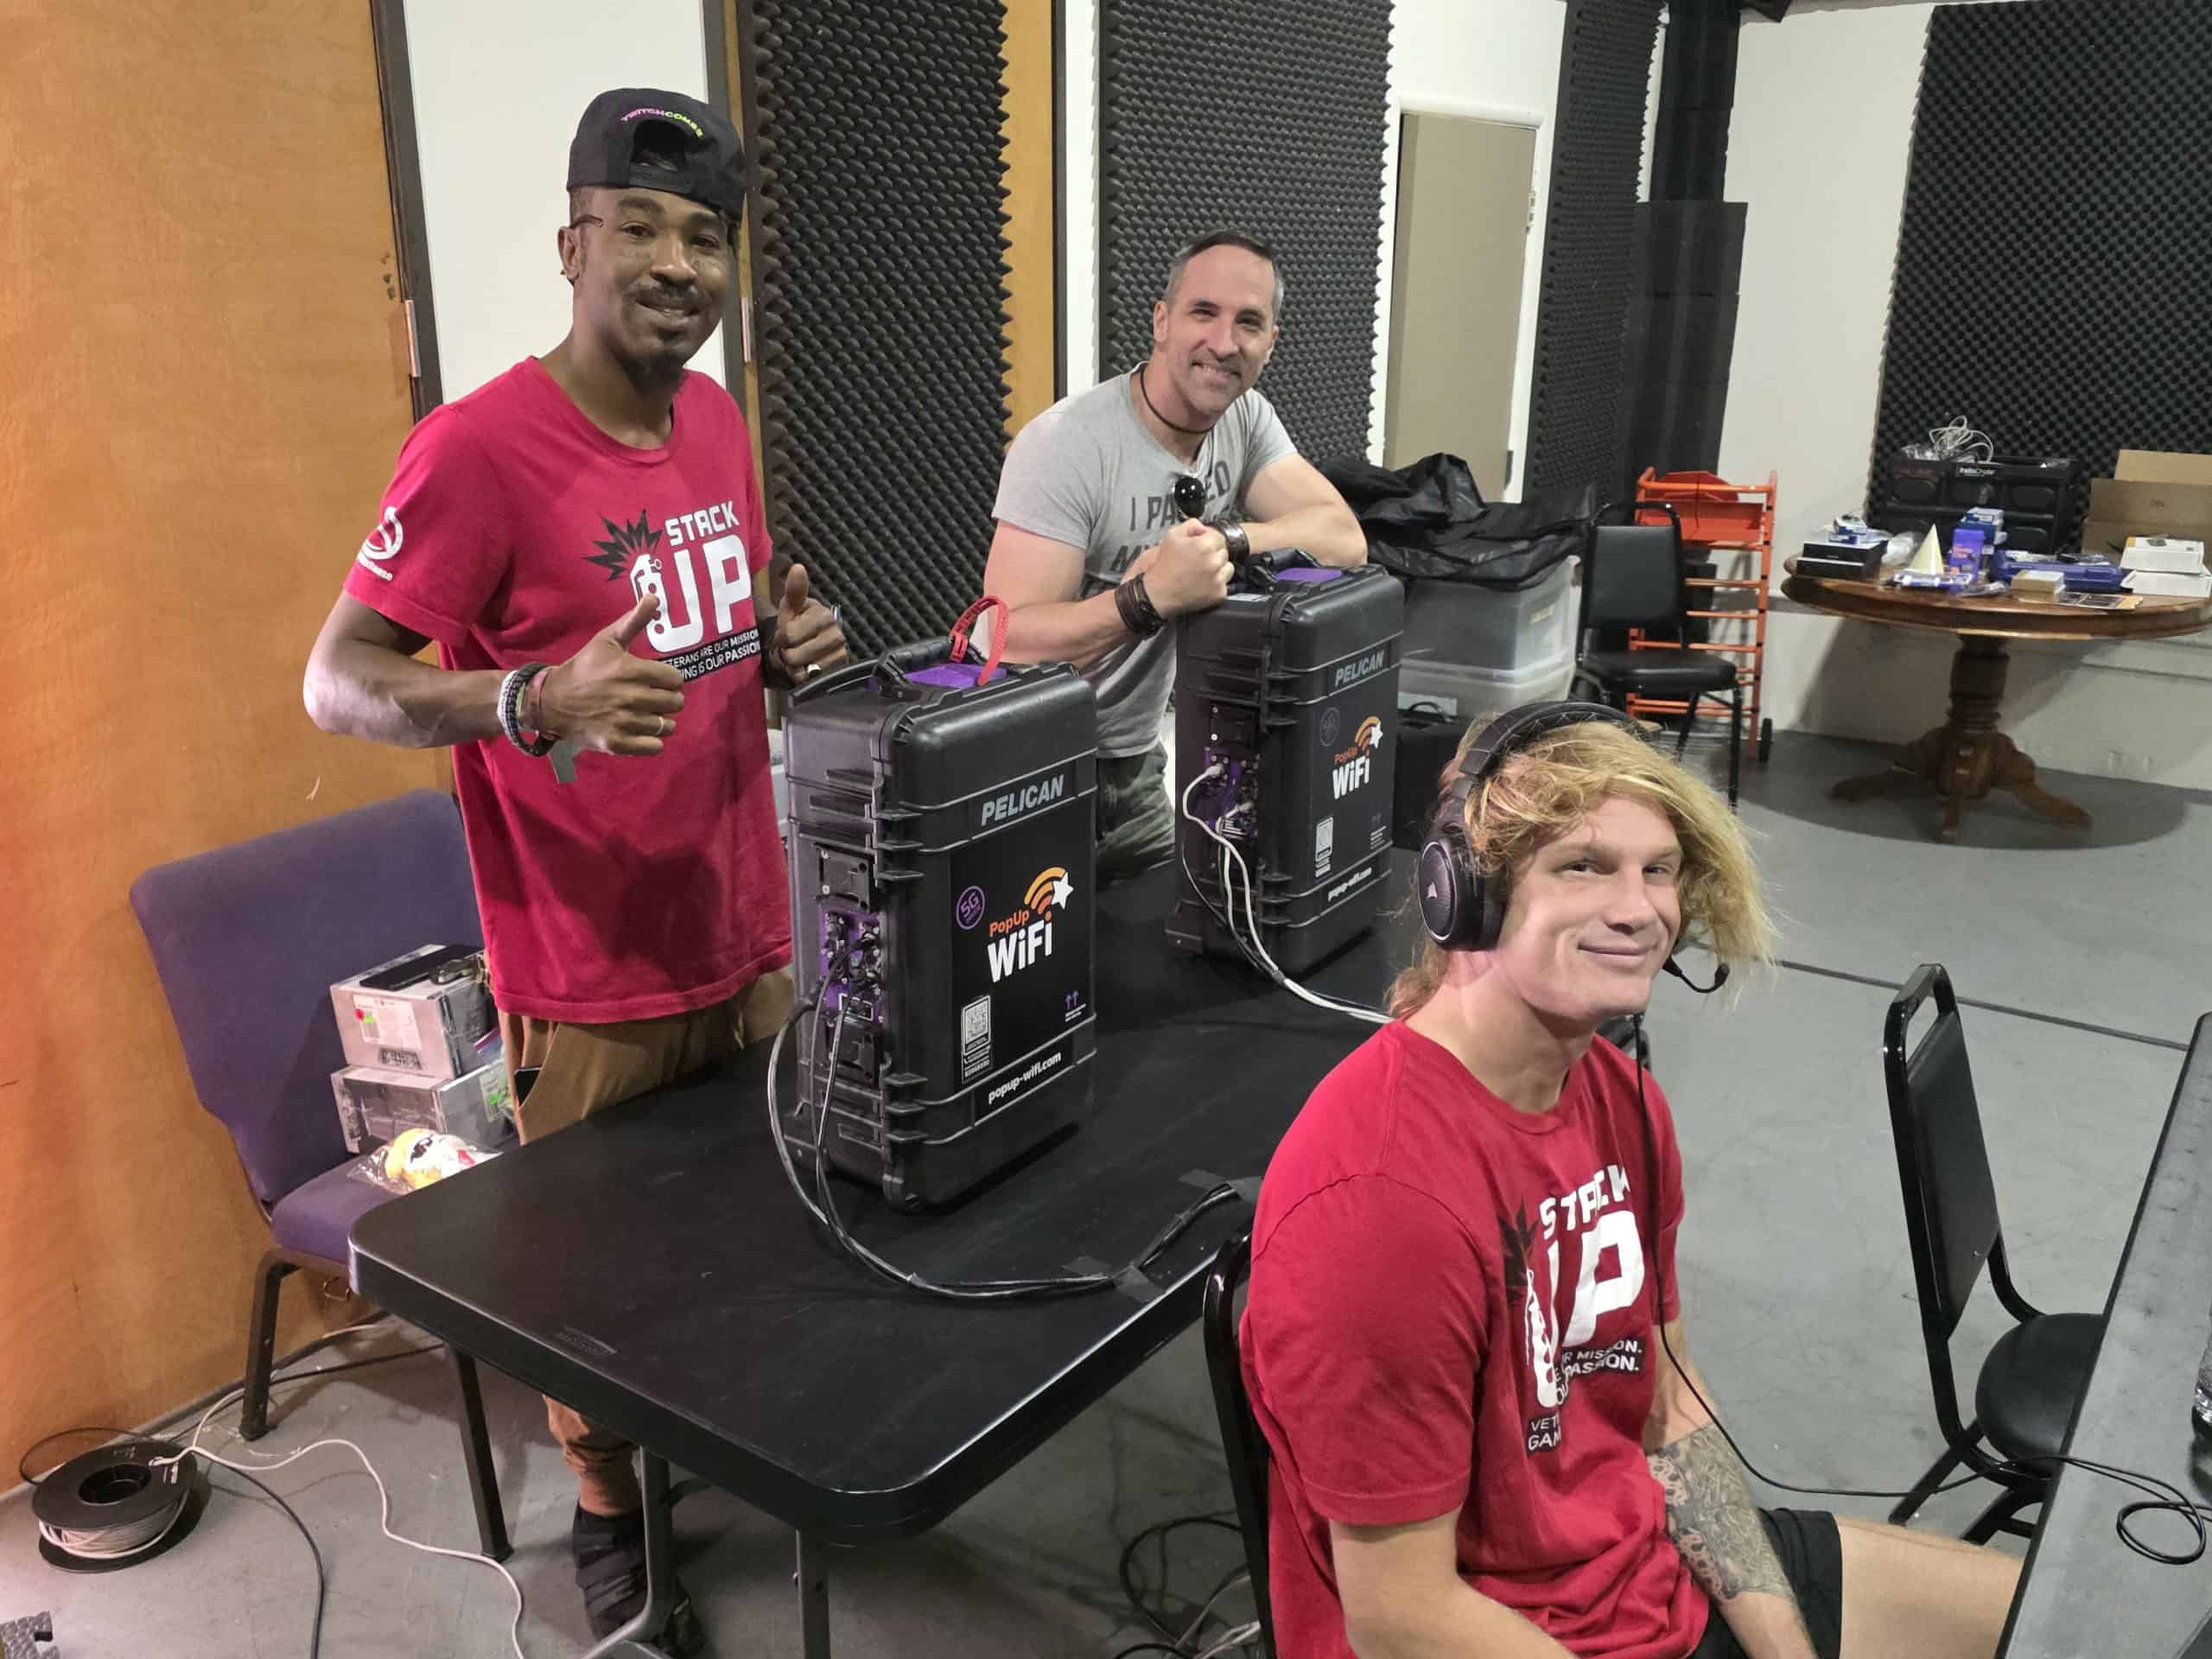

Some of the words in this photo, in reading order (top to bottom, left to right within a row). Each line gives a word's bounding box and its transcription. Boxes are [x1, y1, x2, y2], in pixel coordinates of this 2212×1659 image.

[664, 500, 740, 546] STACK
[630, 534, 752, 653] UP
[705, 654, 725, 671] OUR
[714, 640, 729, 652] OUR
[1334, 650, 1384, 687] PELICAN
[1332, 749, 1370, 800] WiFi
[982, 774, 1065, 827] PELICAN
[987, 911, 1052, 983] WiFi
[989, 909, 1029, 938] PopUp
[988, 1052, 1062, 1105] popup-wifi.com
